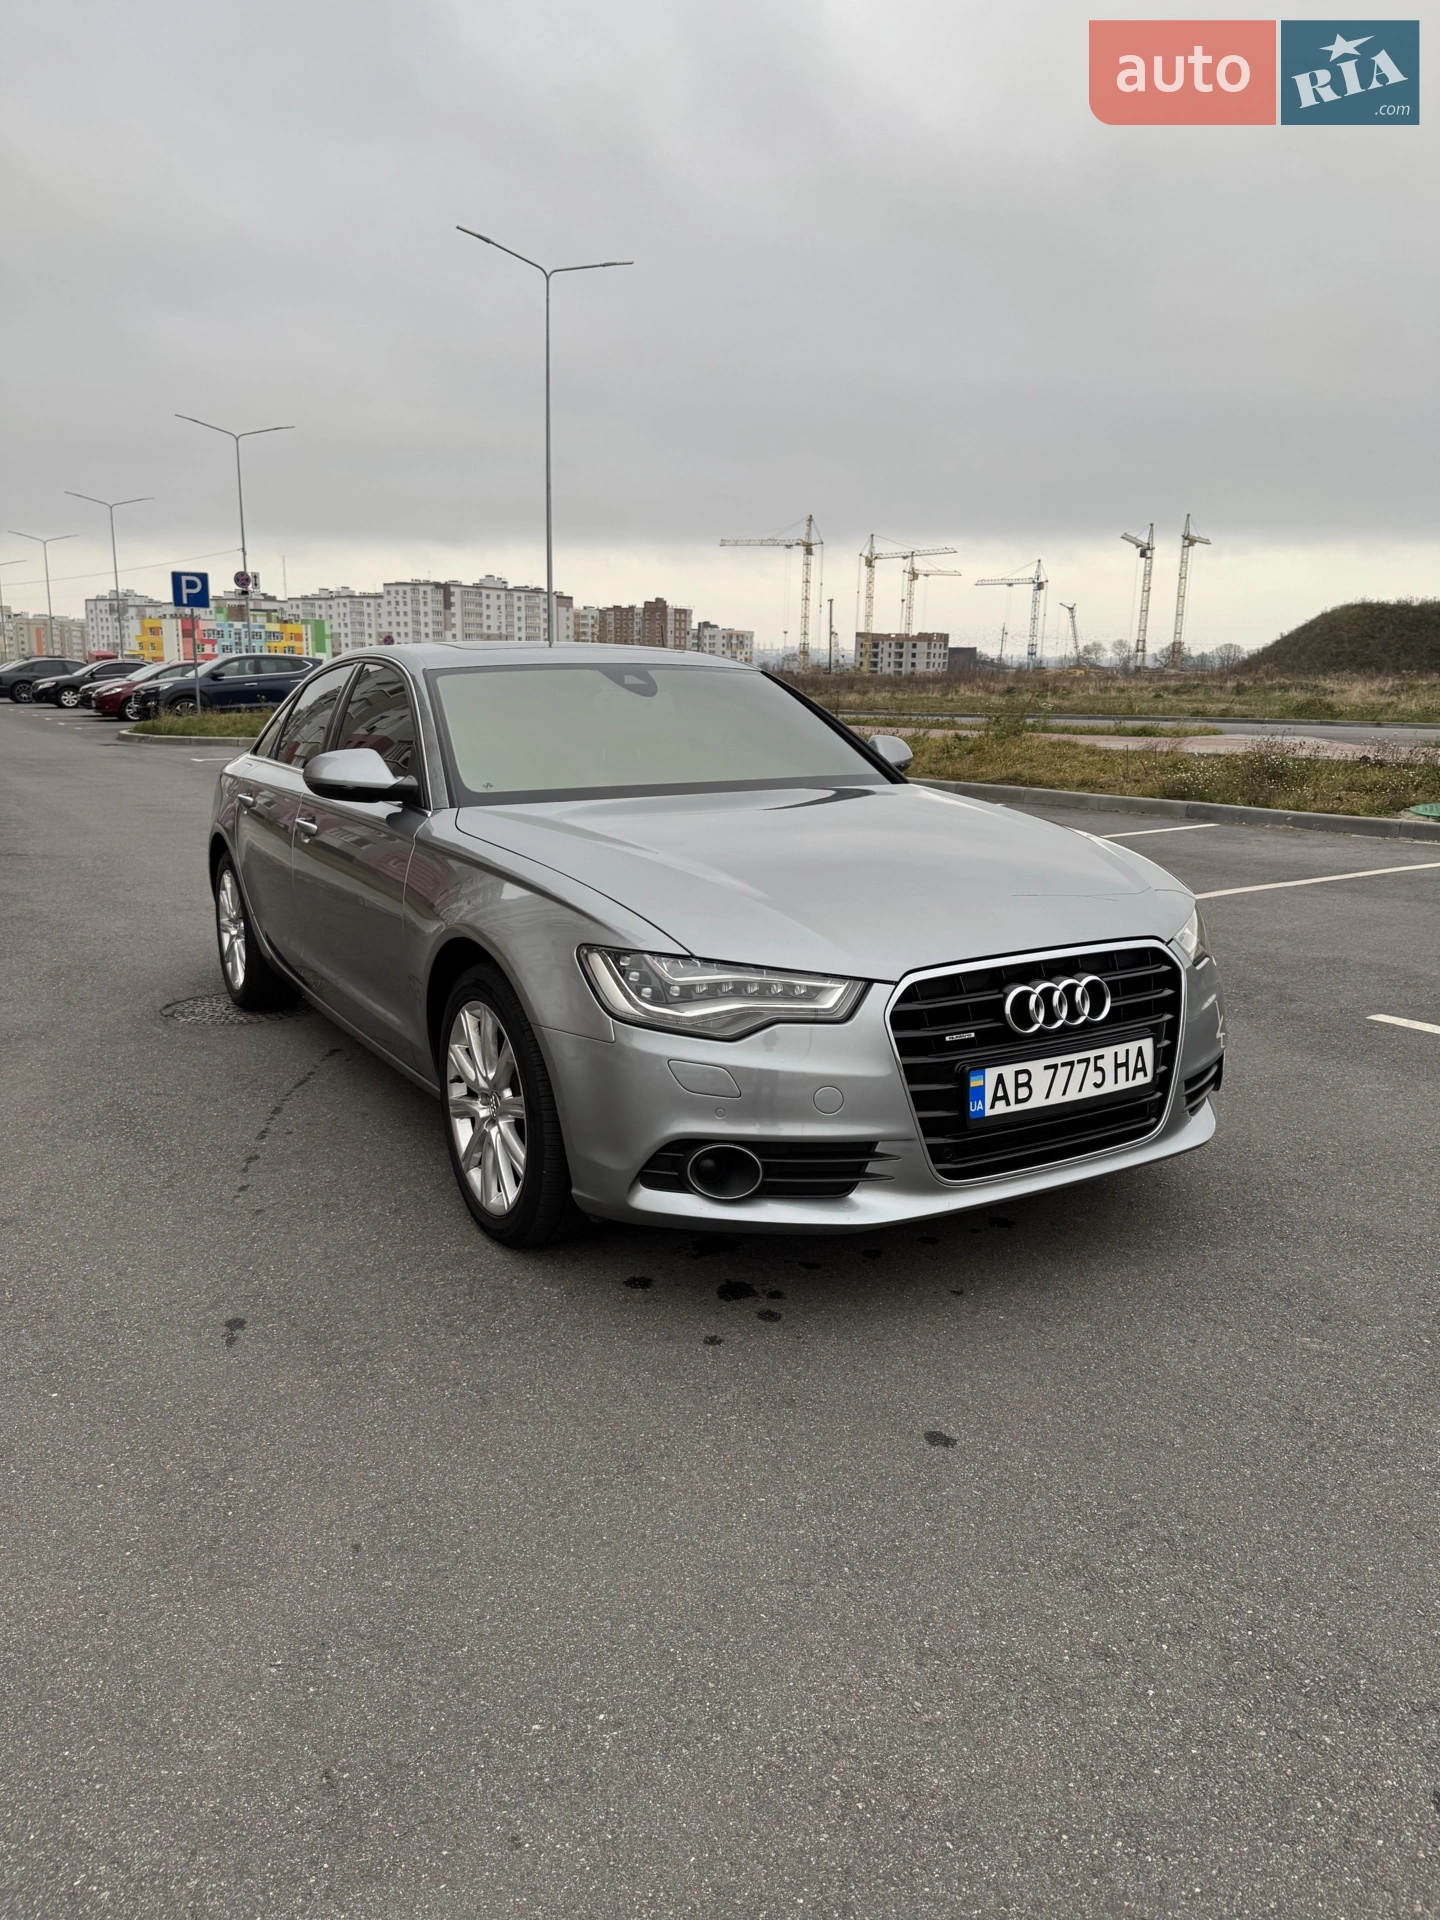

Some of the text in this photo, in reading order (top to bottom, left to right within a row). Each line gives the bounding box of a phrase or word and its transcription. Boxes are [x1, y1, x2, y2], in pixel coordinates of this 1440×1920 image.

[181, 575, 202, 604] P
[989, 1045, 1148, 1110] AB 7775 HA
[970, 1100, 984, 1112] UA
